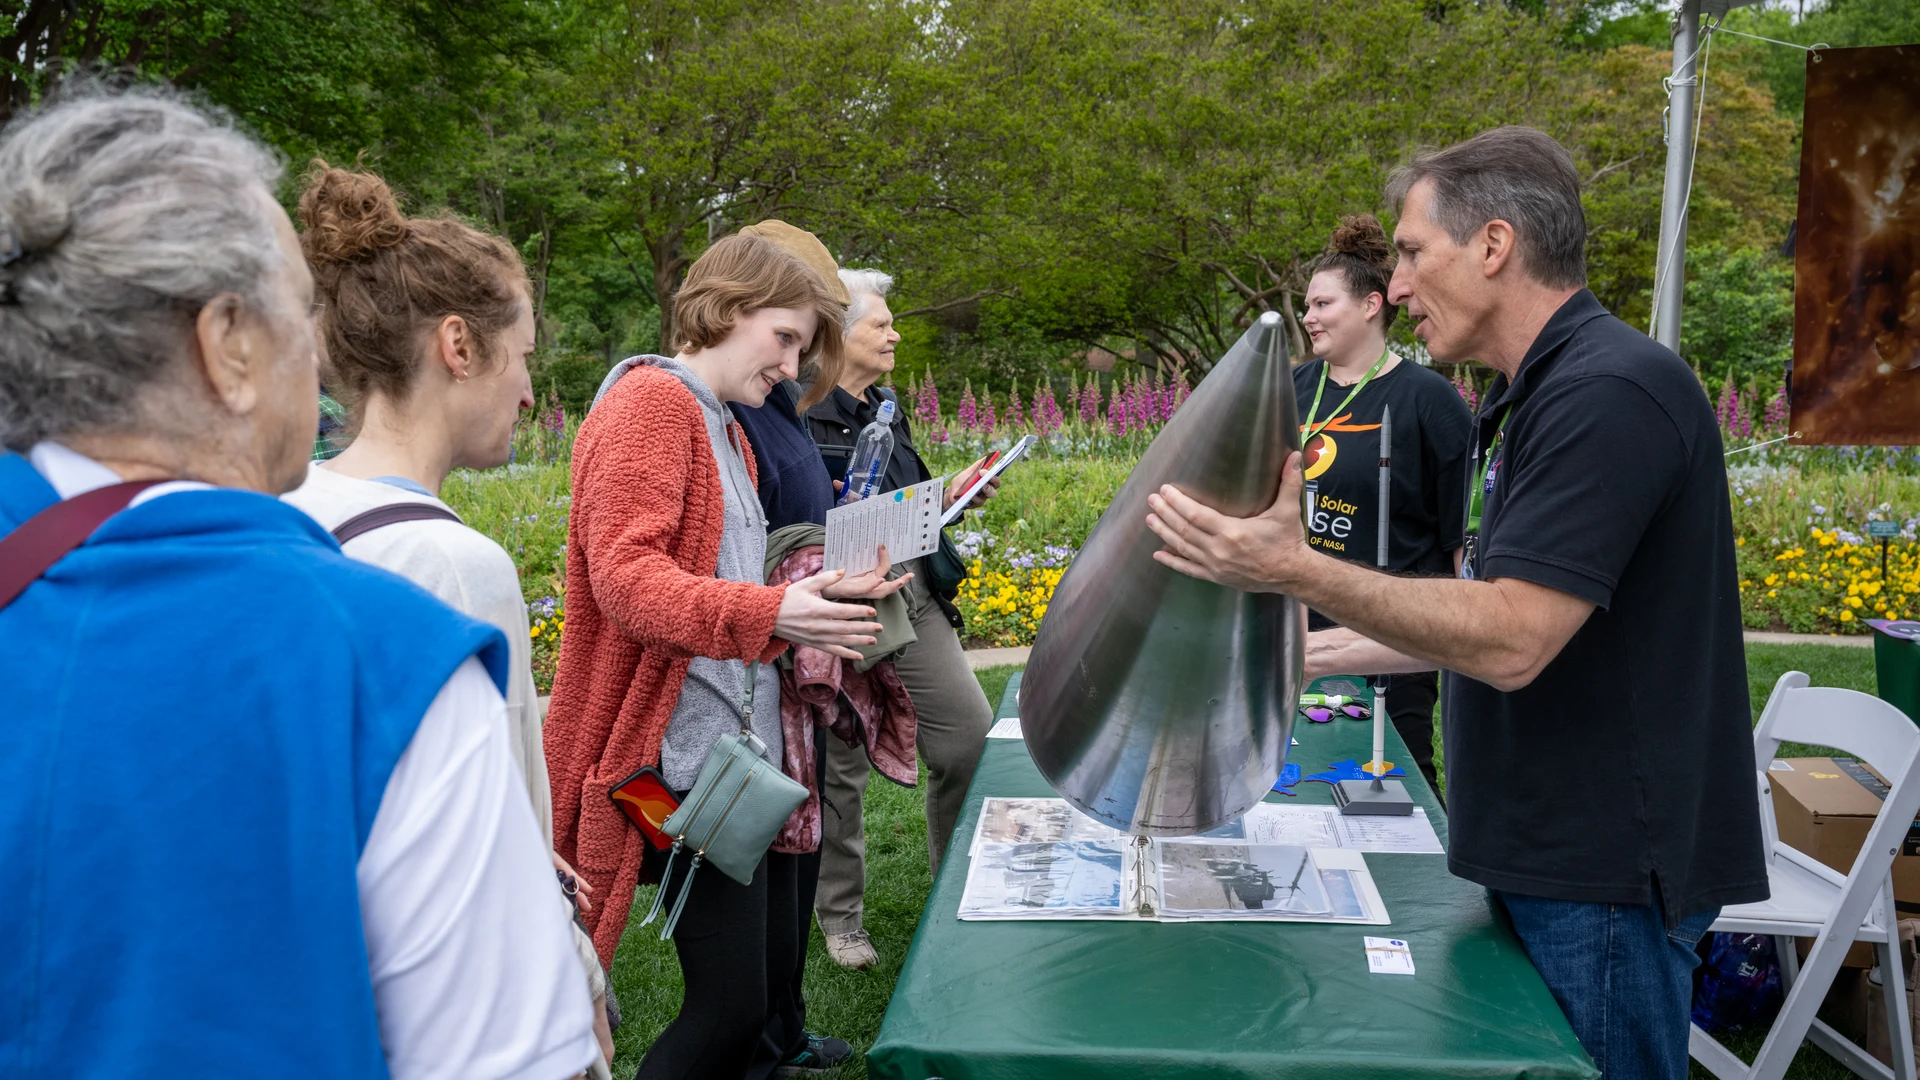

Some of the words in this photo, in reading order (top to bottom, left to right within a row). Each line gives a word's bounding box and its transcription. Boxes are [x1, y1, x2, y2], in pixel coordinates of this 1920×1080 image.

[1320, 495, 1358, 515] Solar
[1310, 536, 1323, 545] OF
[1323, 539, 1345, 551] NASA
